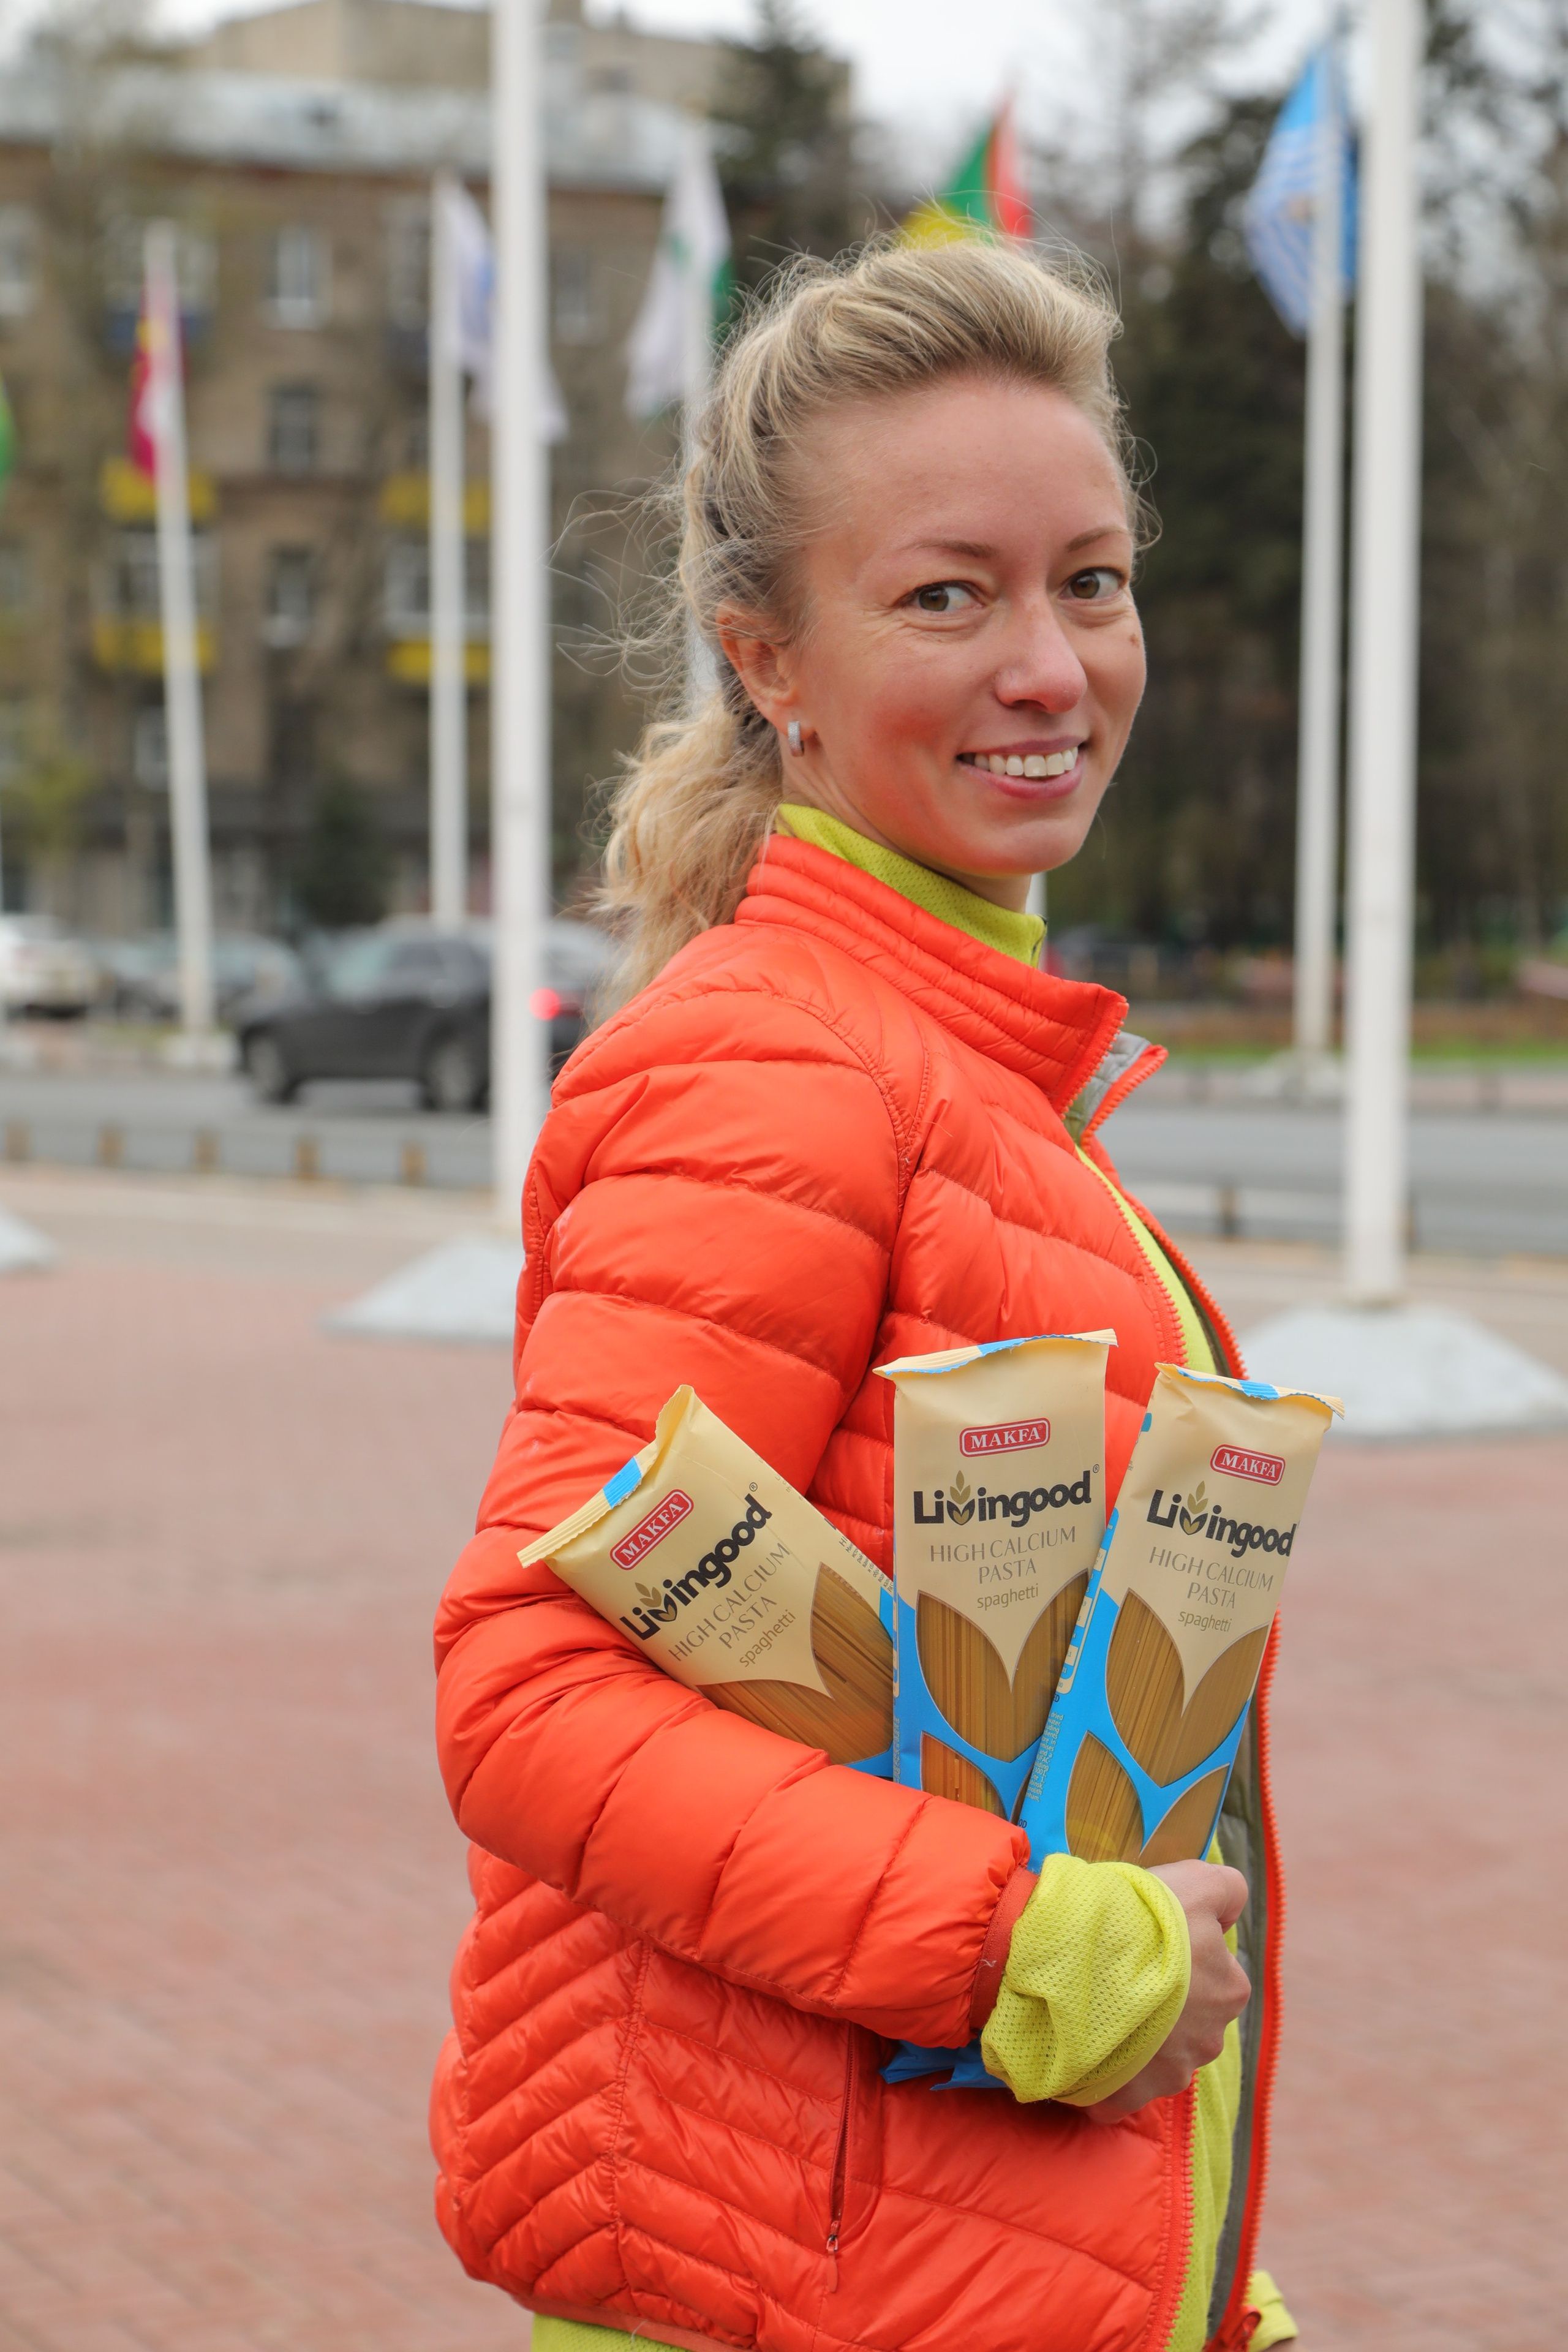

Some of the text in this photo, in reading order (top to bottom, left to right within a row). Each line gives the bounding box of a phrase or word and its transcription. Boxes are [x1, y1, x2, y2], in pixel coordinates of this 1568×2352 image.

[970, 1427, 1041, 1449] MAKFA
[1221, 1452, 1277, 1478] MAKFA
[913, 1470, 1091, 1528] Livingood
[620, 1502, 684, 1561] MAKFA
[930, 1526, 1076, 1562] HIGH CALCIUM
[1146, 1488, 1297, 1558] Livingood
[619, 1493, 773, 1640] Livingood
[979, 1558, 1036, 1585] PASTA
[1149, 1547, 1273, 1592] HIGH CALCIUM
[668, 1618, 717, 1662] HIGH
[713, 1542, 790, 1622] CALCIUM
[977, 1583, 1039, 1611] spaghetti
[1186, 1582, 1235, 1609] PASTA
[718, 1596, 777, 1649] PASTA
[739, 1609, 796, 1667] spaghetti
[1178, 1610, 1232, 1632] spaghetti
